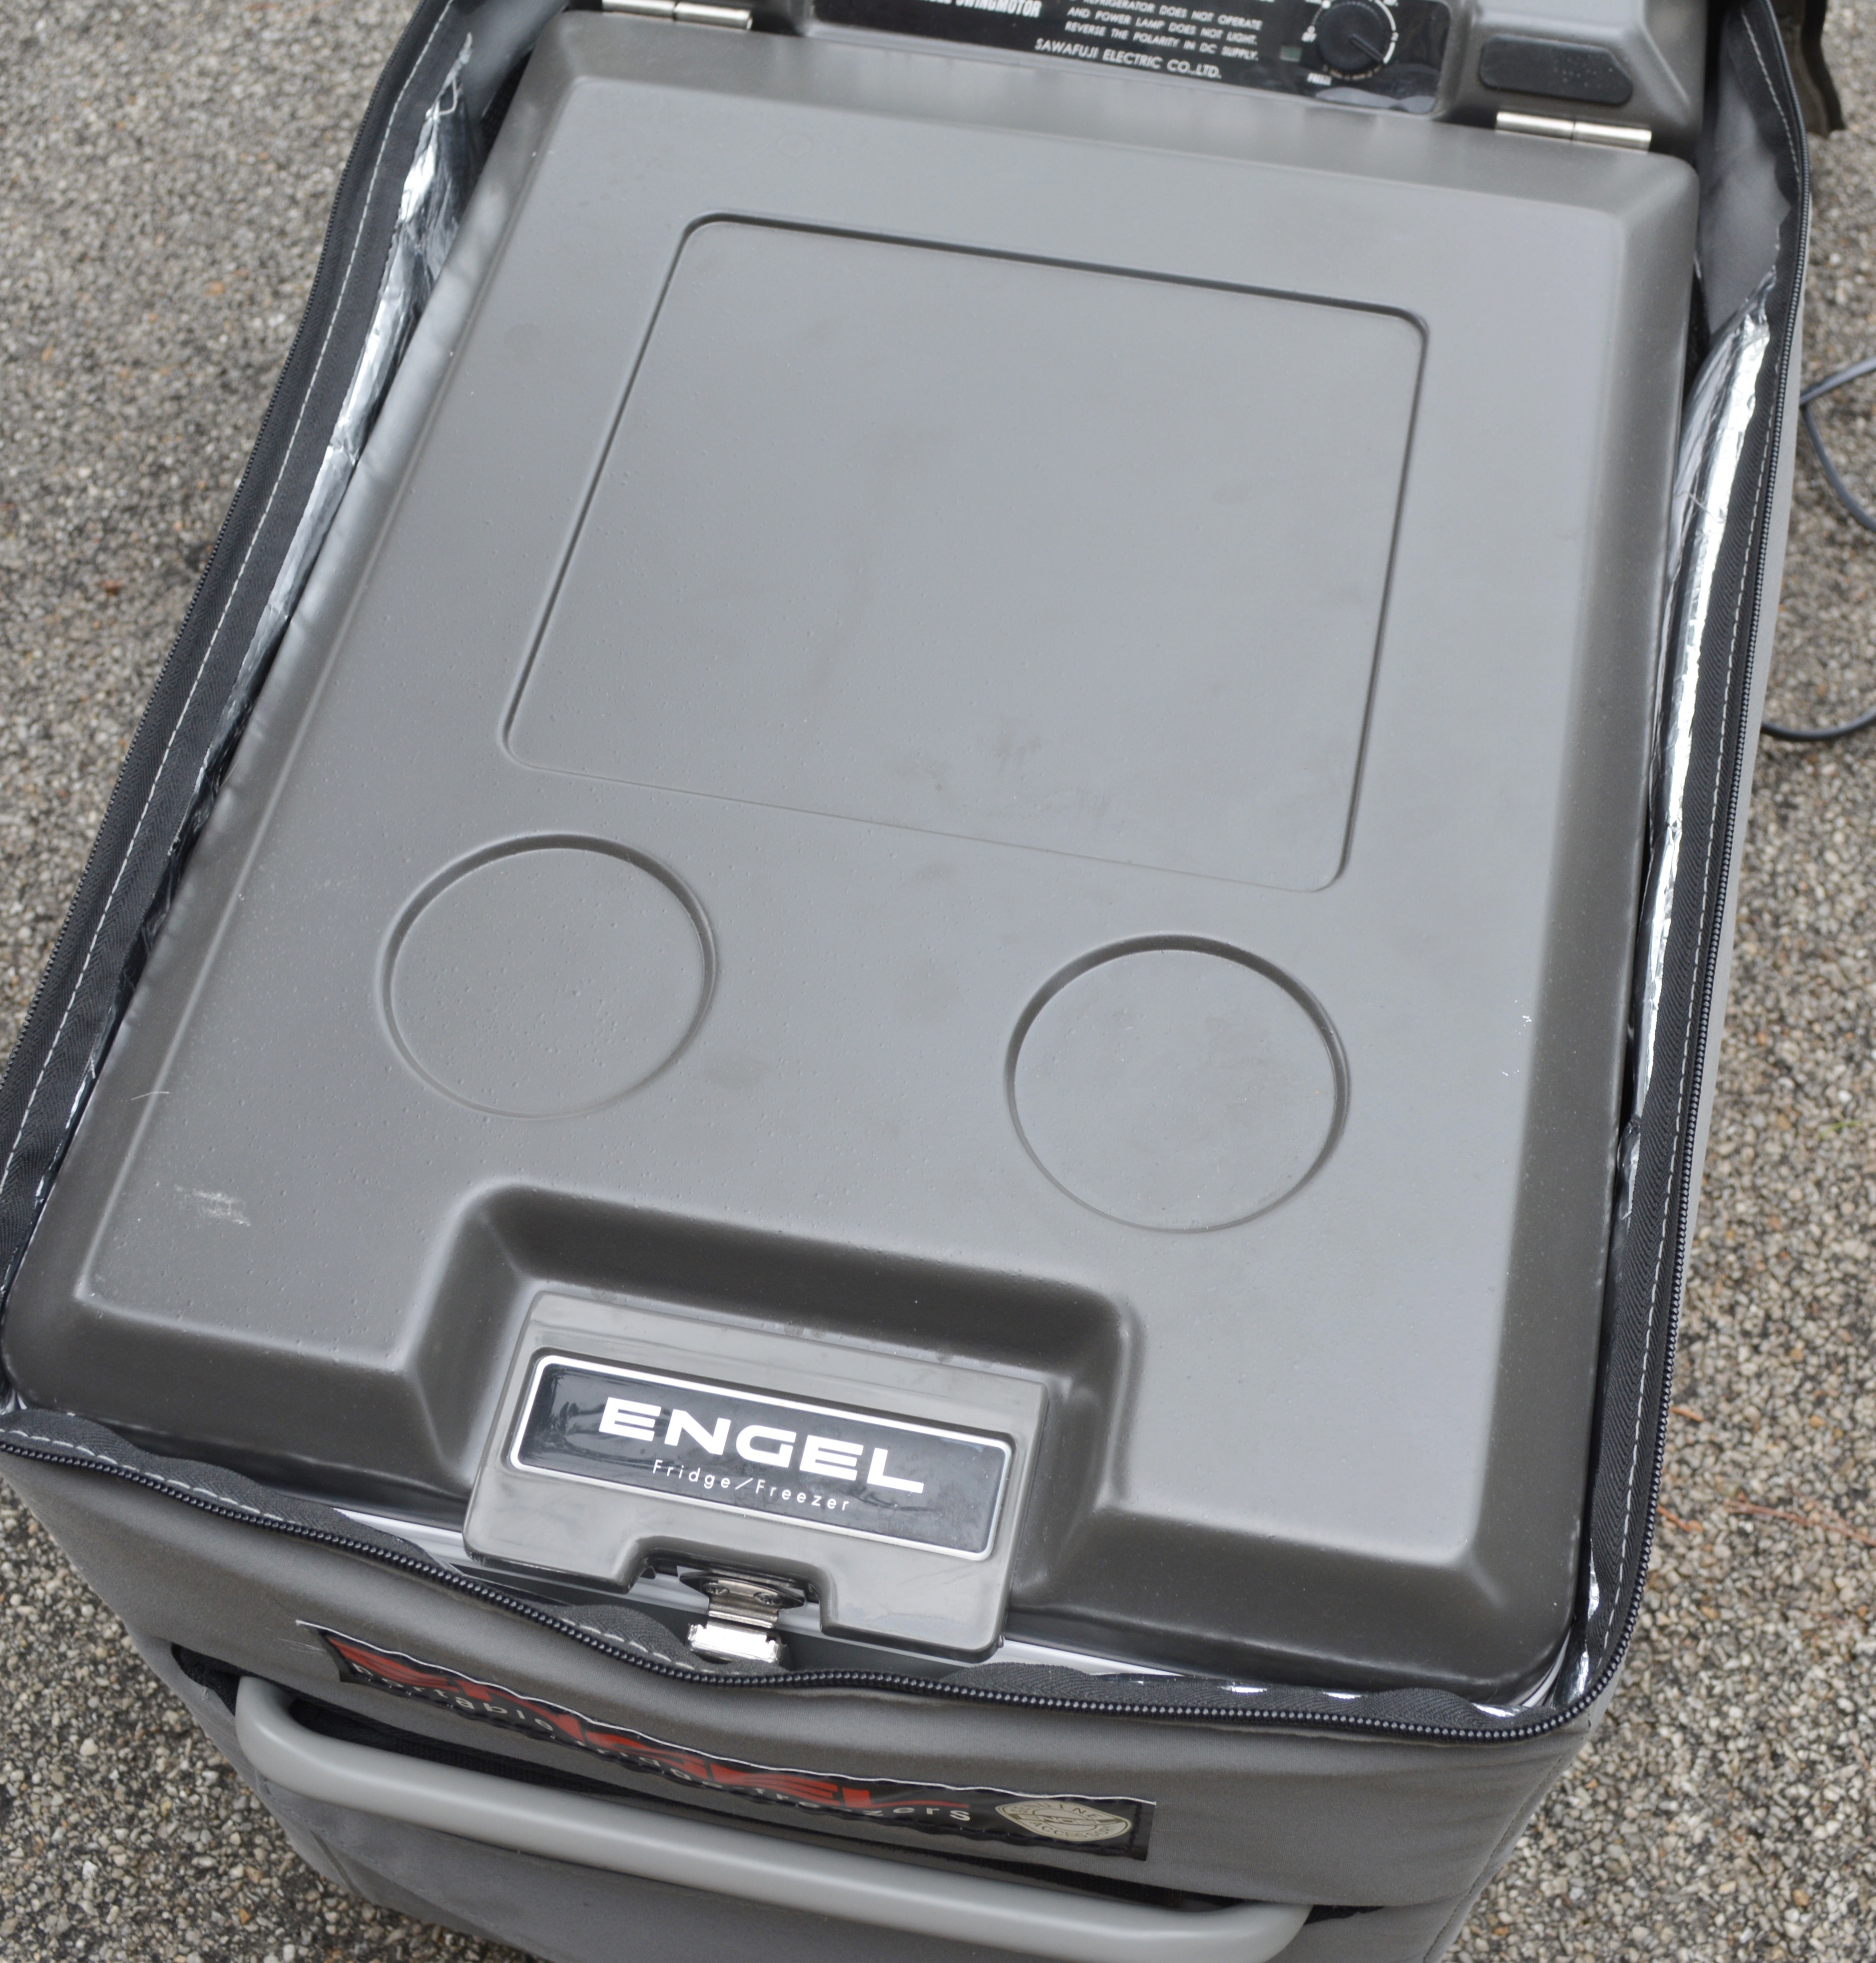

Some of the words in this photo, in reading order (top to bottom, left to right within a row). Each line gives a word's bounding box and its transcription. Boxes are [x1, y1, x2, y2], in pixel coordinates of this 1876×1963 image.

[1067, 6, 1090, 19] AND
[1095, 10, 1131, 25] POWER
[1135, 16, 1165, 30] LAMP
[1168, 21, 1197, 35] DOES
[1200, 27, 1224, 39] NOT
[1159, 4, 1187, 18] DOES
[1191, 10, 1215, 22] NOT
[1217, 14, 1263, 30] OPERATE
[1034, 38, 1099, 59] SAWAFUJI
[1102, 48, 1163, 69] ELECTRIC
[1064, 21, 1107, 36] REVERSE
[1111, 28, 1129, 40] THE
[1133, 31, 1181, 48] POLARITY
[1183, 40, 1196, 51] IN
[1199, 42, 1218, 54] DC
[598, 1397, 925, 1494] ENGEL
[652, 1459, 852, 1511] Fridge/Freezer
[352, 1661, 554, 1733] portable
